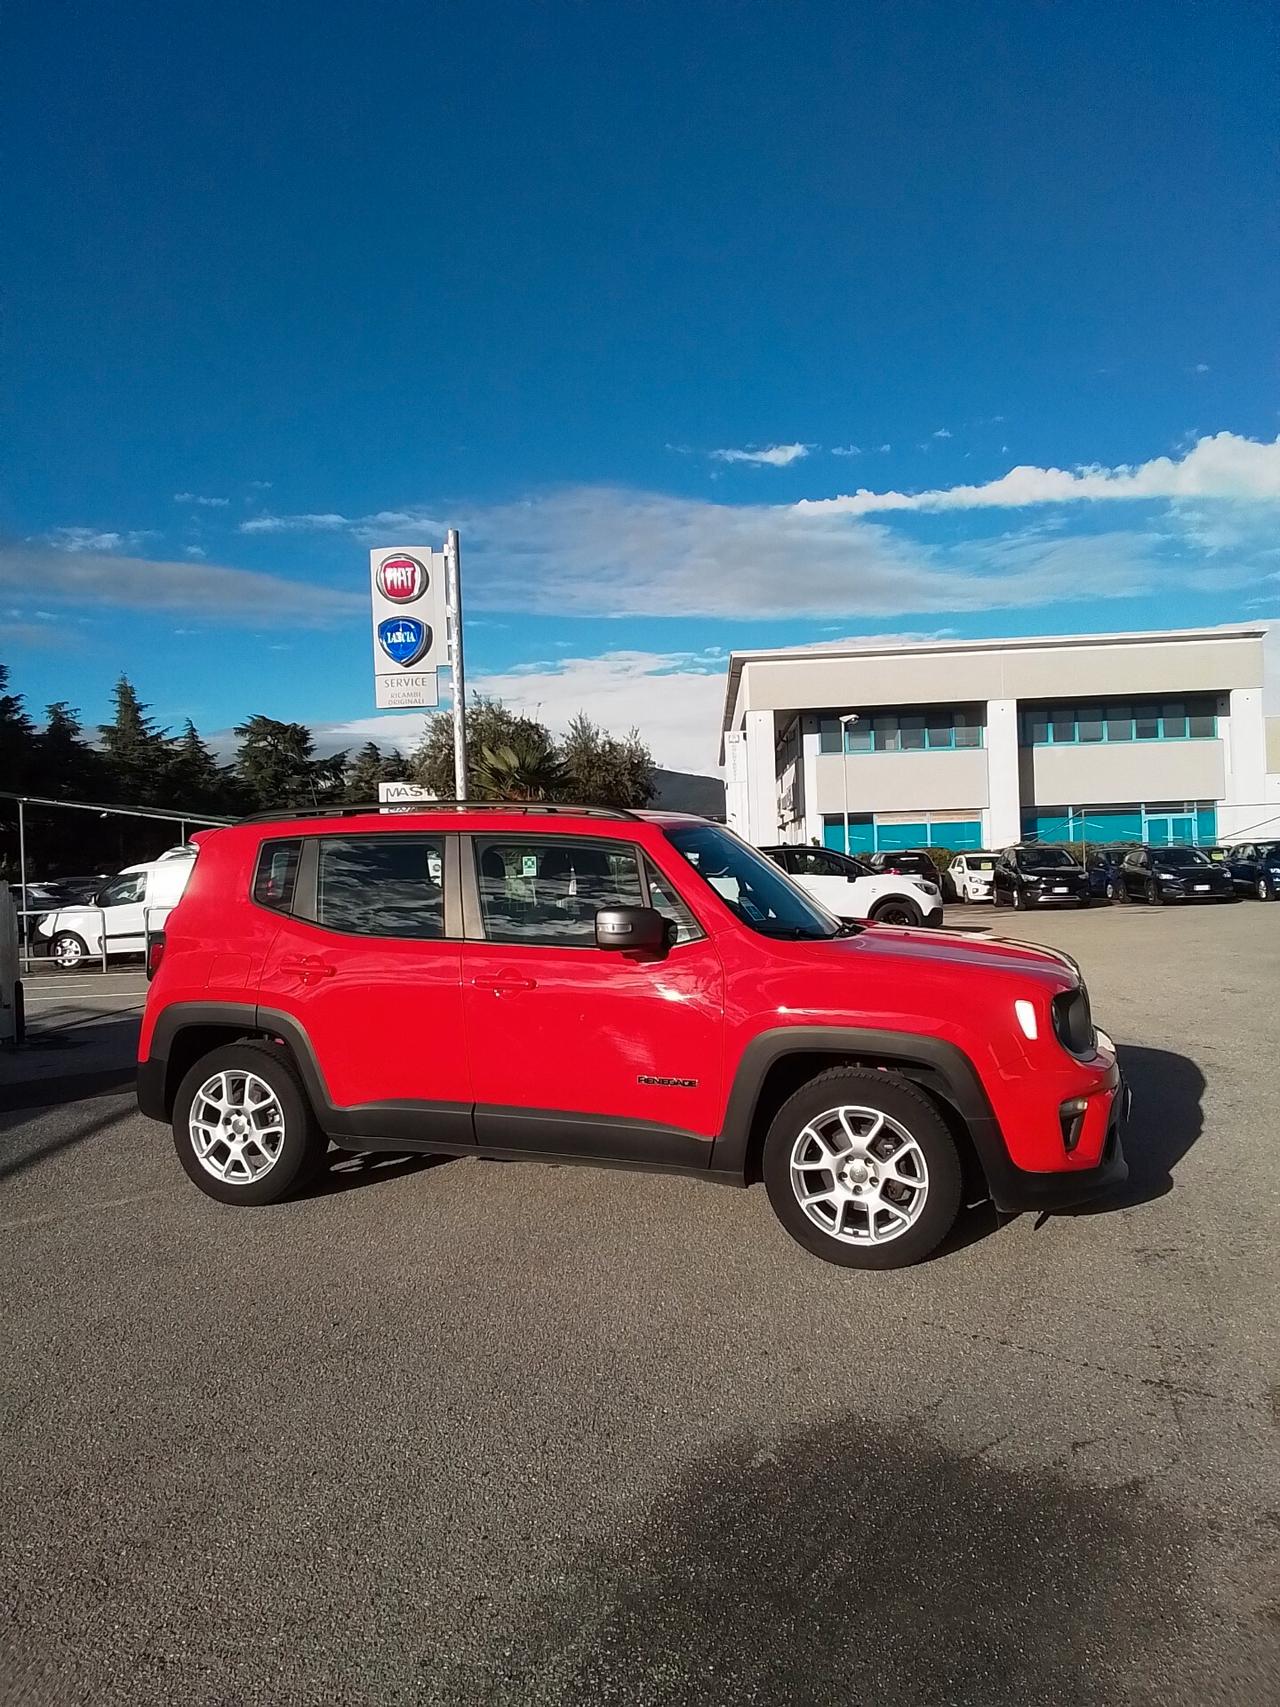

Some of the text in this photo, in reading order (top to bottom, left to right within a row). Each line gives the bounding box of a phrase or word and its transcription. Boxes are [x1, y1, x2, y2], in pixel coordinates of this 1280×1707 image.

[385, 567, 414, 590] FIAT
[384, 678, 427, 688] SERVICE
[637, 1076, 698, 1088] RENEGADE
